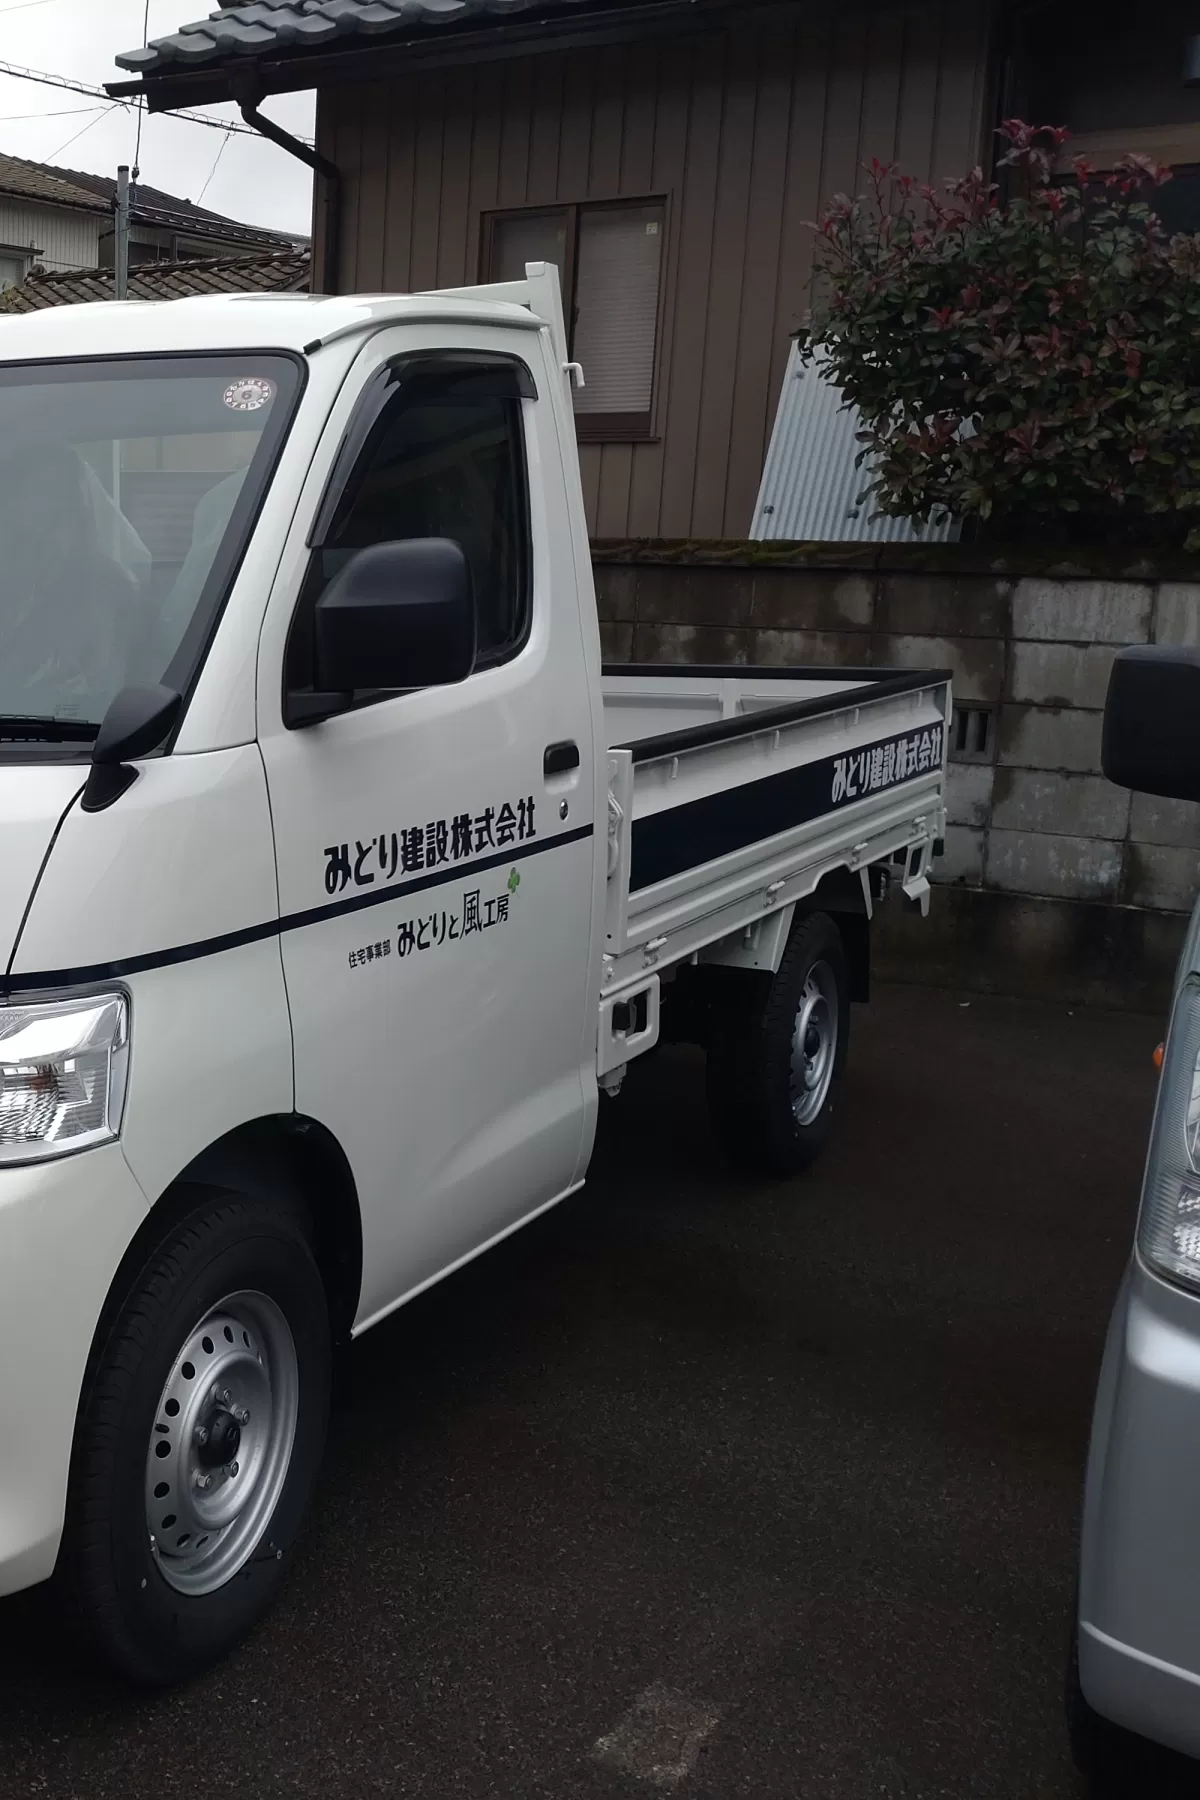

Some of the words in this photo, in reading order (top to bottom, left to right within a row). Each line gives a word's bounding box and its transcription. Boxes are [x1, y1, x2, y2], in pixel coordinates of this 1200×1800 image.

[832, 727, 942, 803] みどり建設株式会社
[323, 795, 537, 895] みどり建設株式会社
[348, 939, 391, 969] 住宅事業部
[397, 888, 510, 957] みどりと風工房
